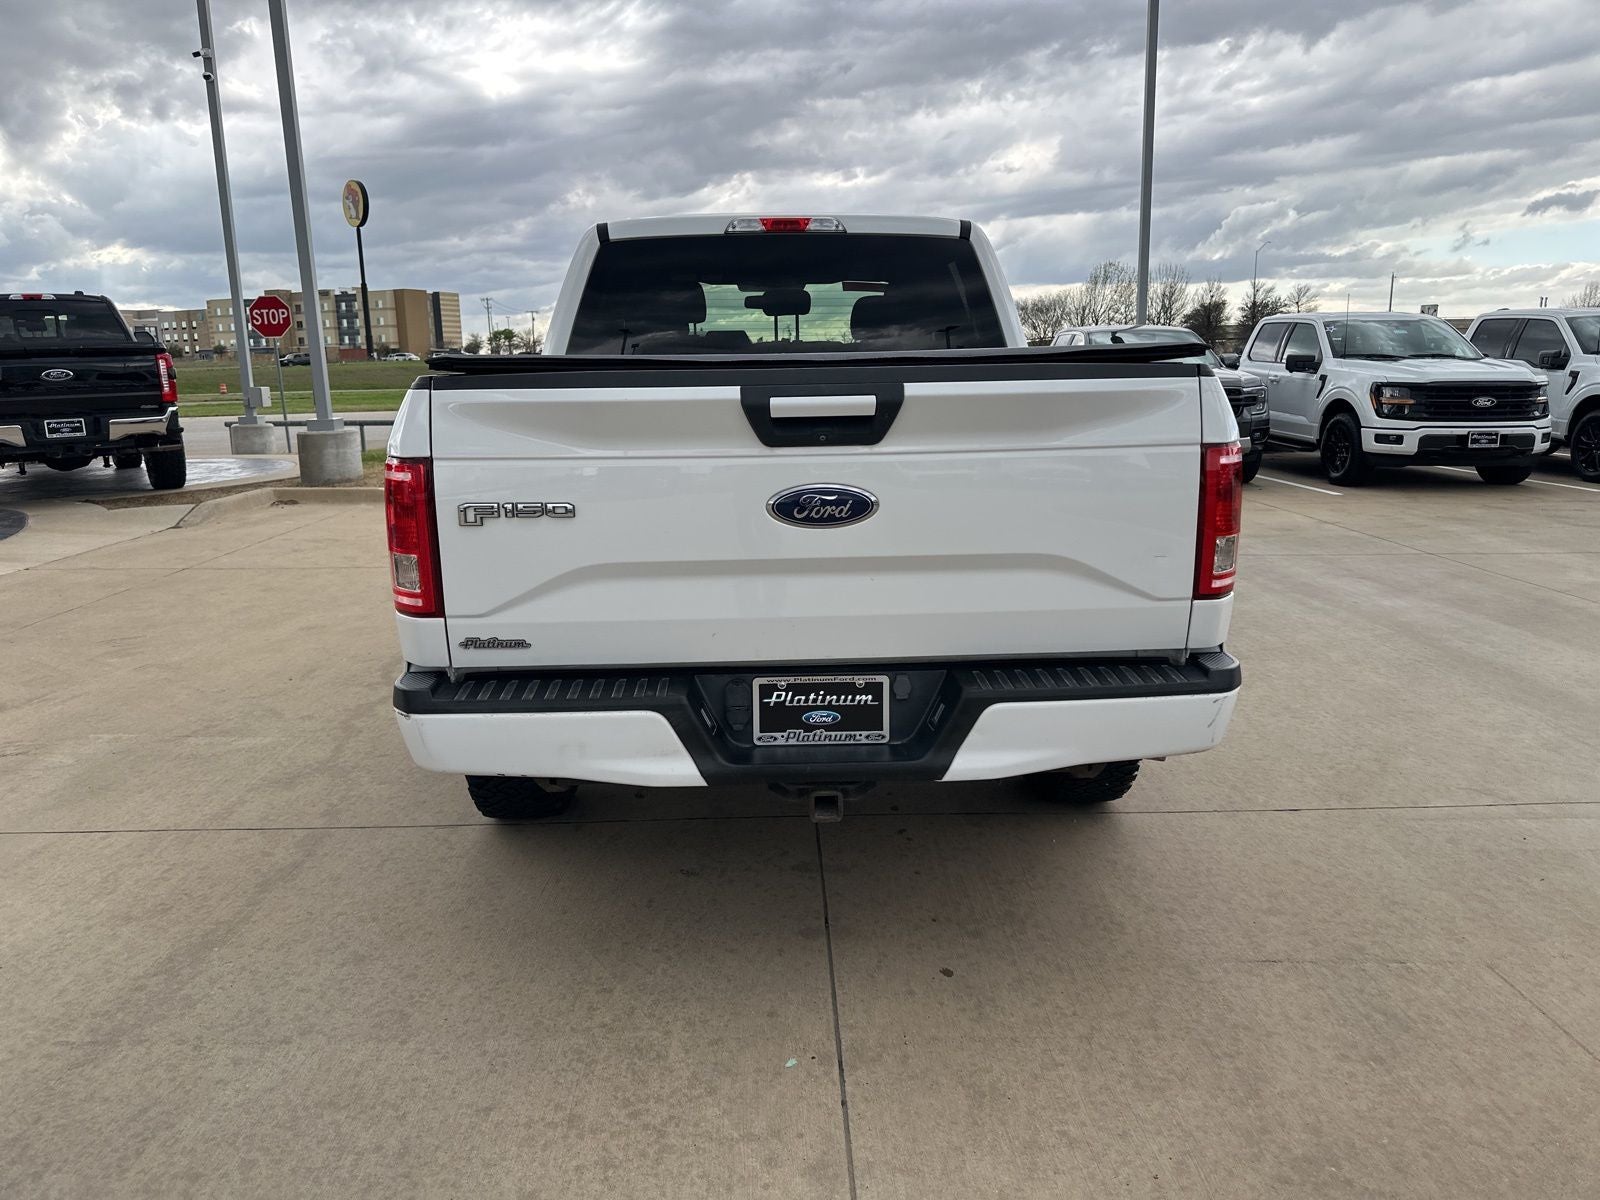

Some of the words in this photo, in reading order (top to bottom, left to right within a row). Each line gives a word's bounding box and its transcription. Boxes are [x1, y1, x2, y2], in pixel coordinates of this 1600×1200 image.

[252, 308, 289, 326] STOP
[793, 494, 853, 519] Ford
[459, 637, 532, 649] Platinum
[762, 691, 879, 707] Platinum
[809, 712, 834, 723] Ford
[785, 730, 860, 742] Platinum
